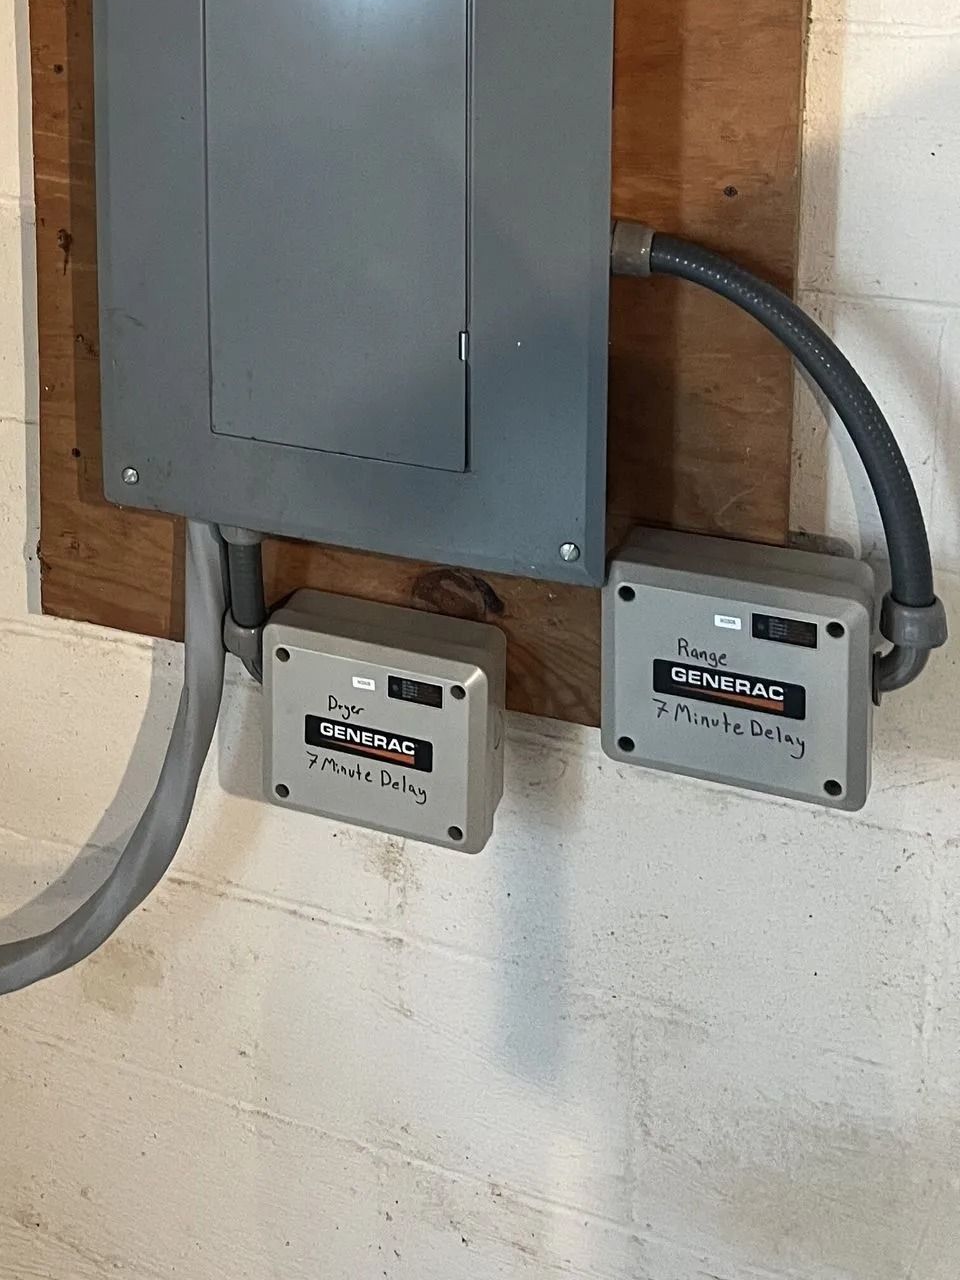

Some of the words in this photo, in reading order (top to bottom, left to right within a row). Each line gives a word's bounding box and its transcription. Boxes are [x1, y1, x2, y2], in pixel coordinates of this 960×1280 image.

[677, 637, 728, 668] Range
[671, 667, 785, 701] GENERAC
[327, 695, 365, 720] Dryer
[319, 721, 416, 756] GENERAC
[652, 698, 669, 719] 7
[673, 703, 745, 736] Minute
[750, 720, 806, 760] Delay
[305, 751, 319, 769] 7
[321, 757, 373, 783] Minute
[380, 769, 428, 805] Delay
